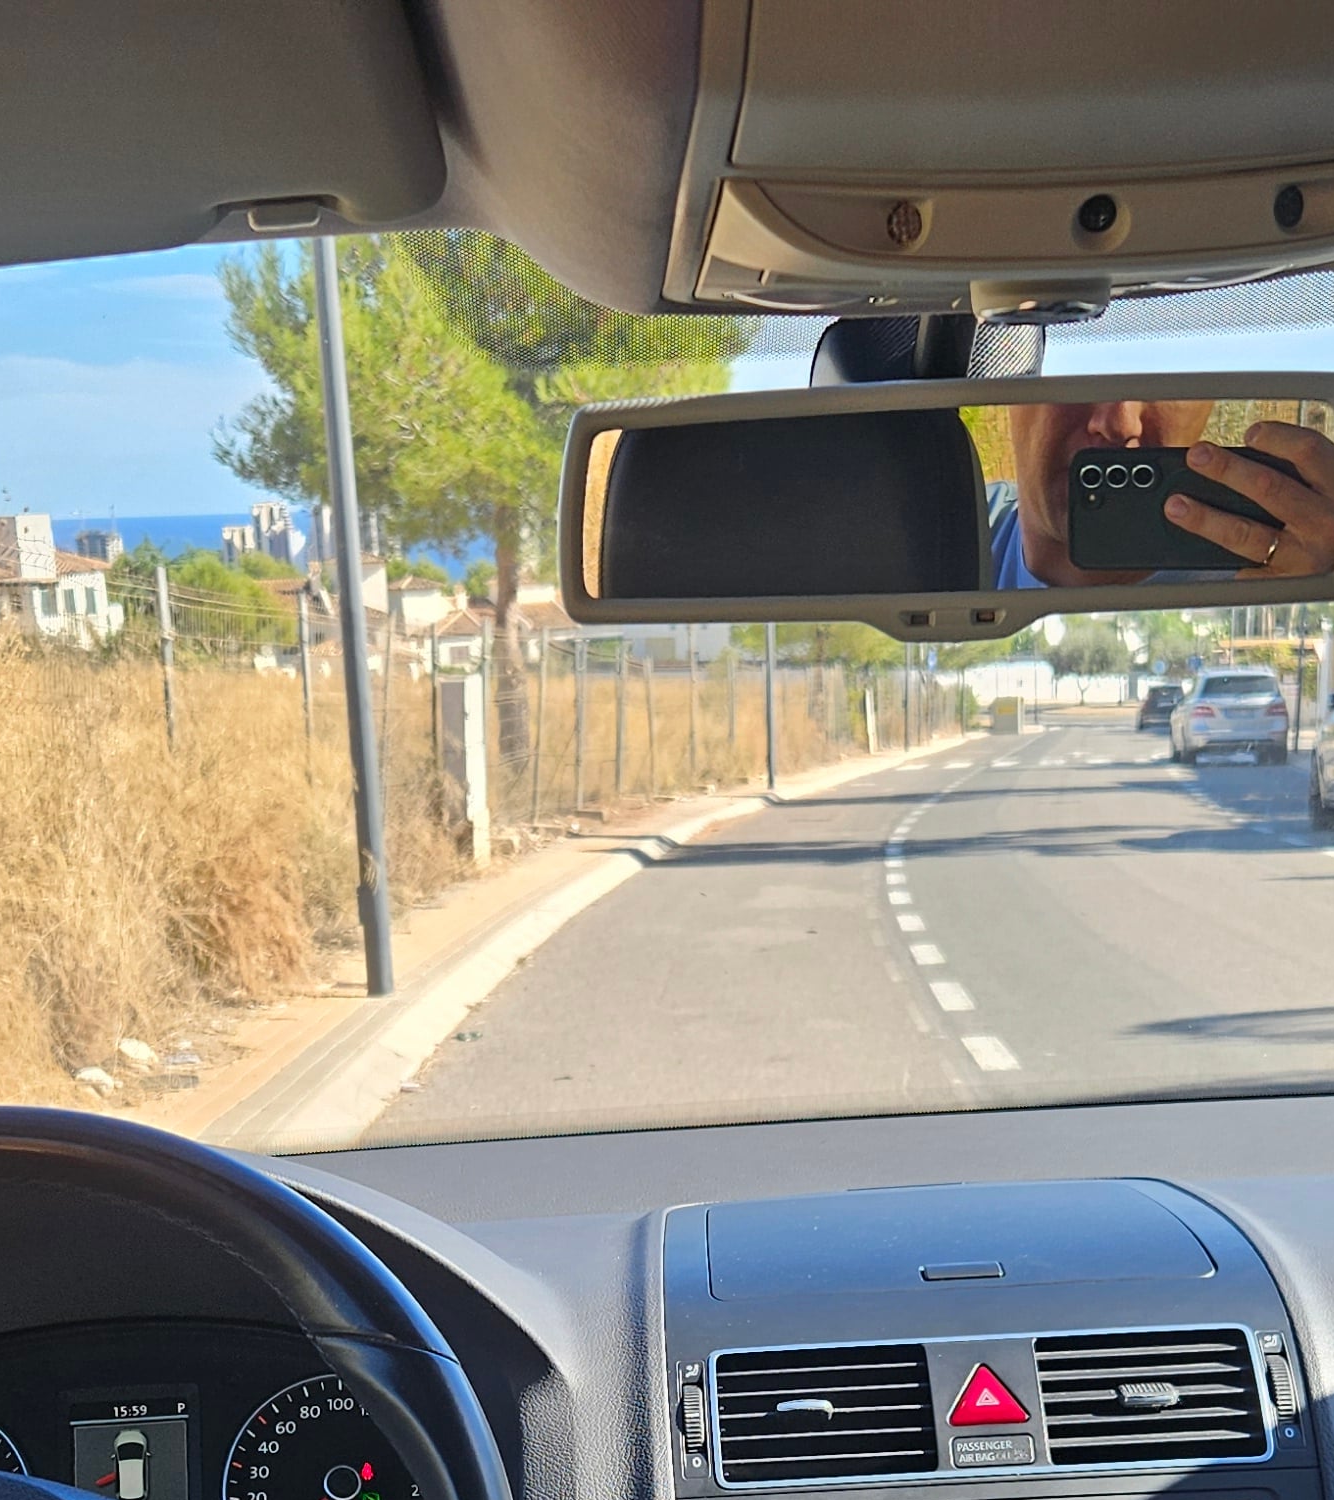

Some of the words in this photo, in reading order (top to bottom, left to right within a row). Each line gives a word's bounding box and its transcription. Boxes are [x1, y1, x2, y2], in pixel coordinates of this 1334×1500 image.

[113, 1404, 148, 1417] 15:59
[177, 1403, 185, 1413] P
[327, 1398, 354, 1411] 100
[299, 1406, 321, 1419] 80
[275, 1421, 297, 1435] 60
[257, 1441, 280, 1454] 40
[956, 1440, 1013, 1452] PASSENGER
[959, 1452, 995, 1463] AIRBAG
[249, 1466, 270, 1479] 30
